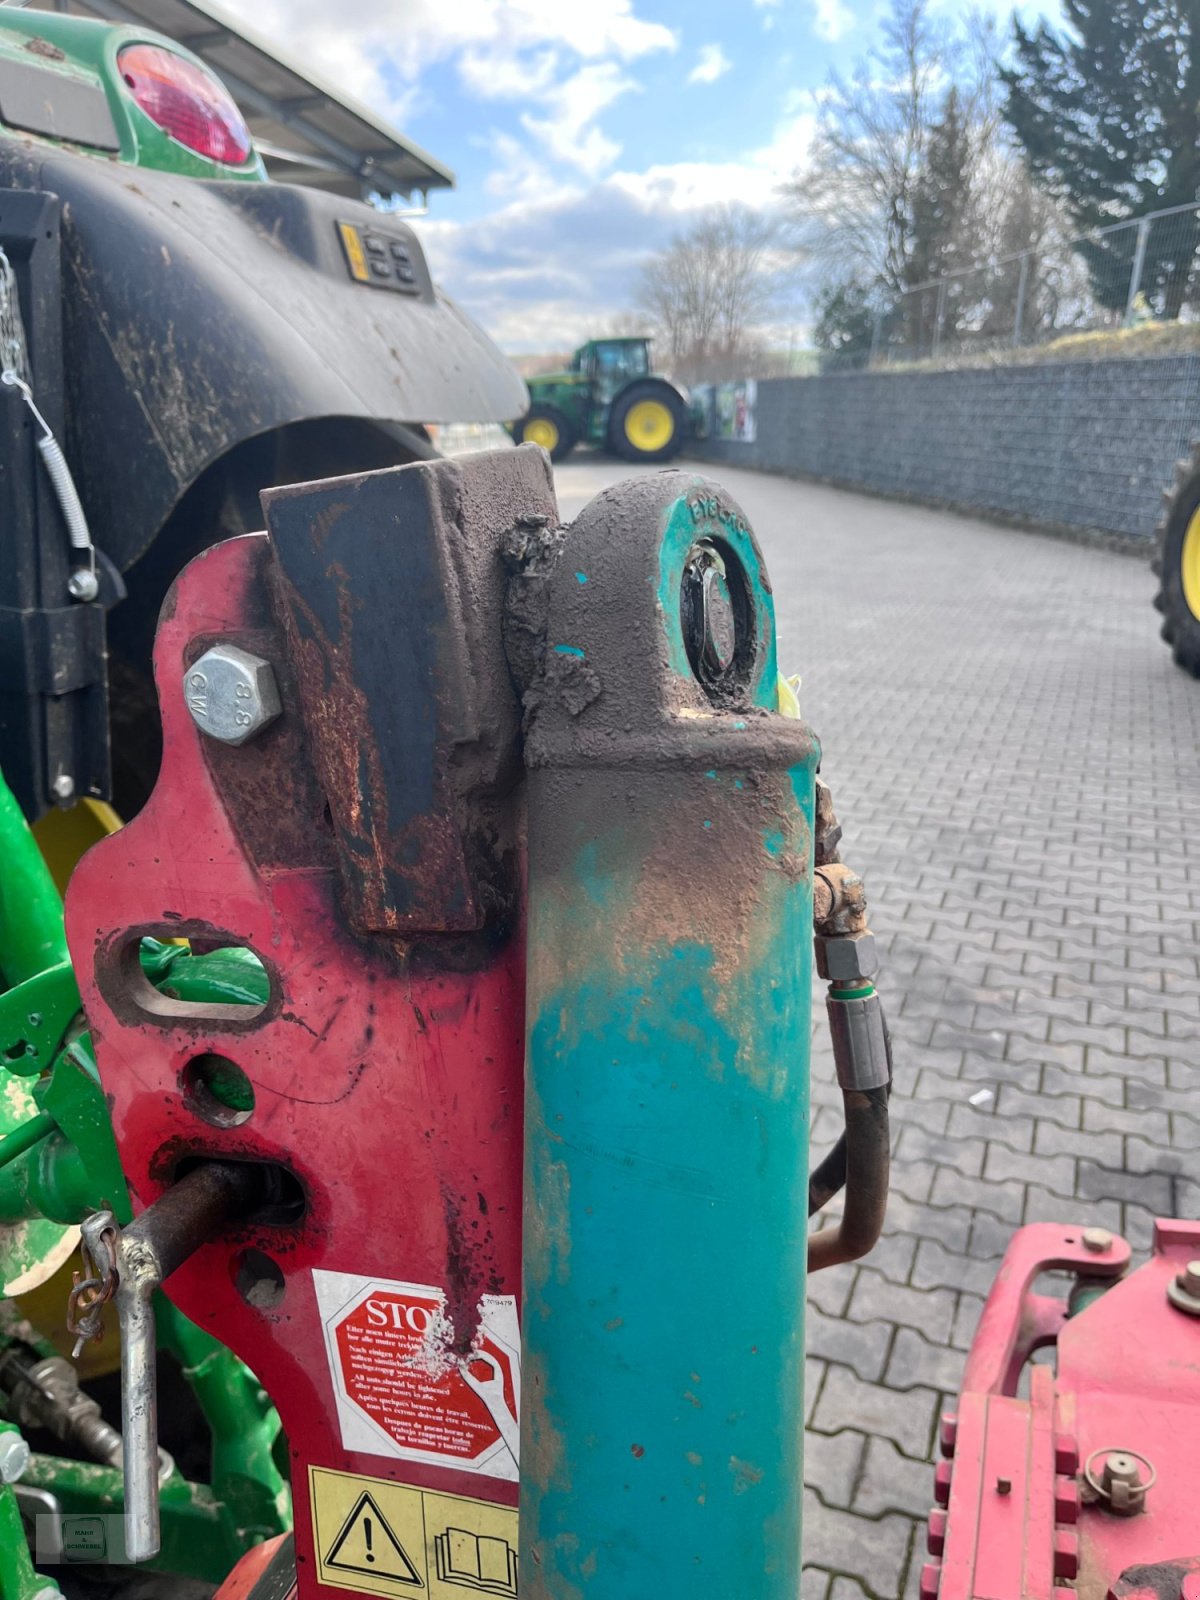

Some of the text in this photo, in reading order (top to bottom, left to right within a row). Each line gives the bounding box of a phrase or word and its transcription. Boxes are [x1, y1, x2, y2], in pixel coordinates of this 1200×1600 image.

[235, 681, 253, 727] 8.8
[365, 1299, 440, 1333] STO
[354, 1373, 365, 1381] All
[382, 1378, 405, 1388] should
[407, 1381, 416, 1390] be
[417, 1384, 450, 1396] tightened
[392, 1387, 412, 1398] hours
[366, 1402, 381, 1411] tous
[382, 1404, 392, 1412] les
[417, 1411, 443, 1422] doivent
[411, 1401, 434, 1412] heures
[435, 1406, 444, 1414] de
[390, 1425, 417, 1436] trabajo
[451, 1436, 471, 1446] todos
[395, 1433, 406, 1441] los
[407, 1435, 437, 1446] tornillos
[413, 1421, 422, 1429] de
[444, 1427, 464, 1437] horas
[465, 1431, 474, 1439] de
